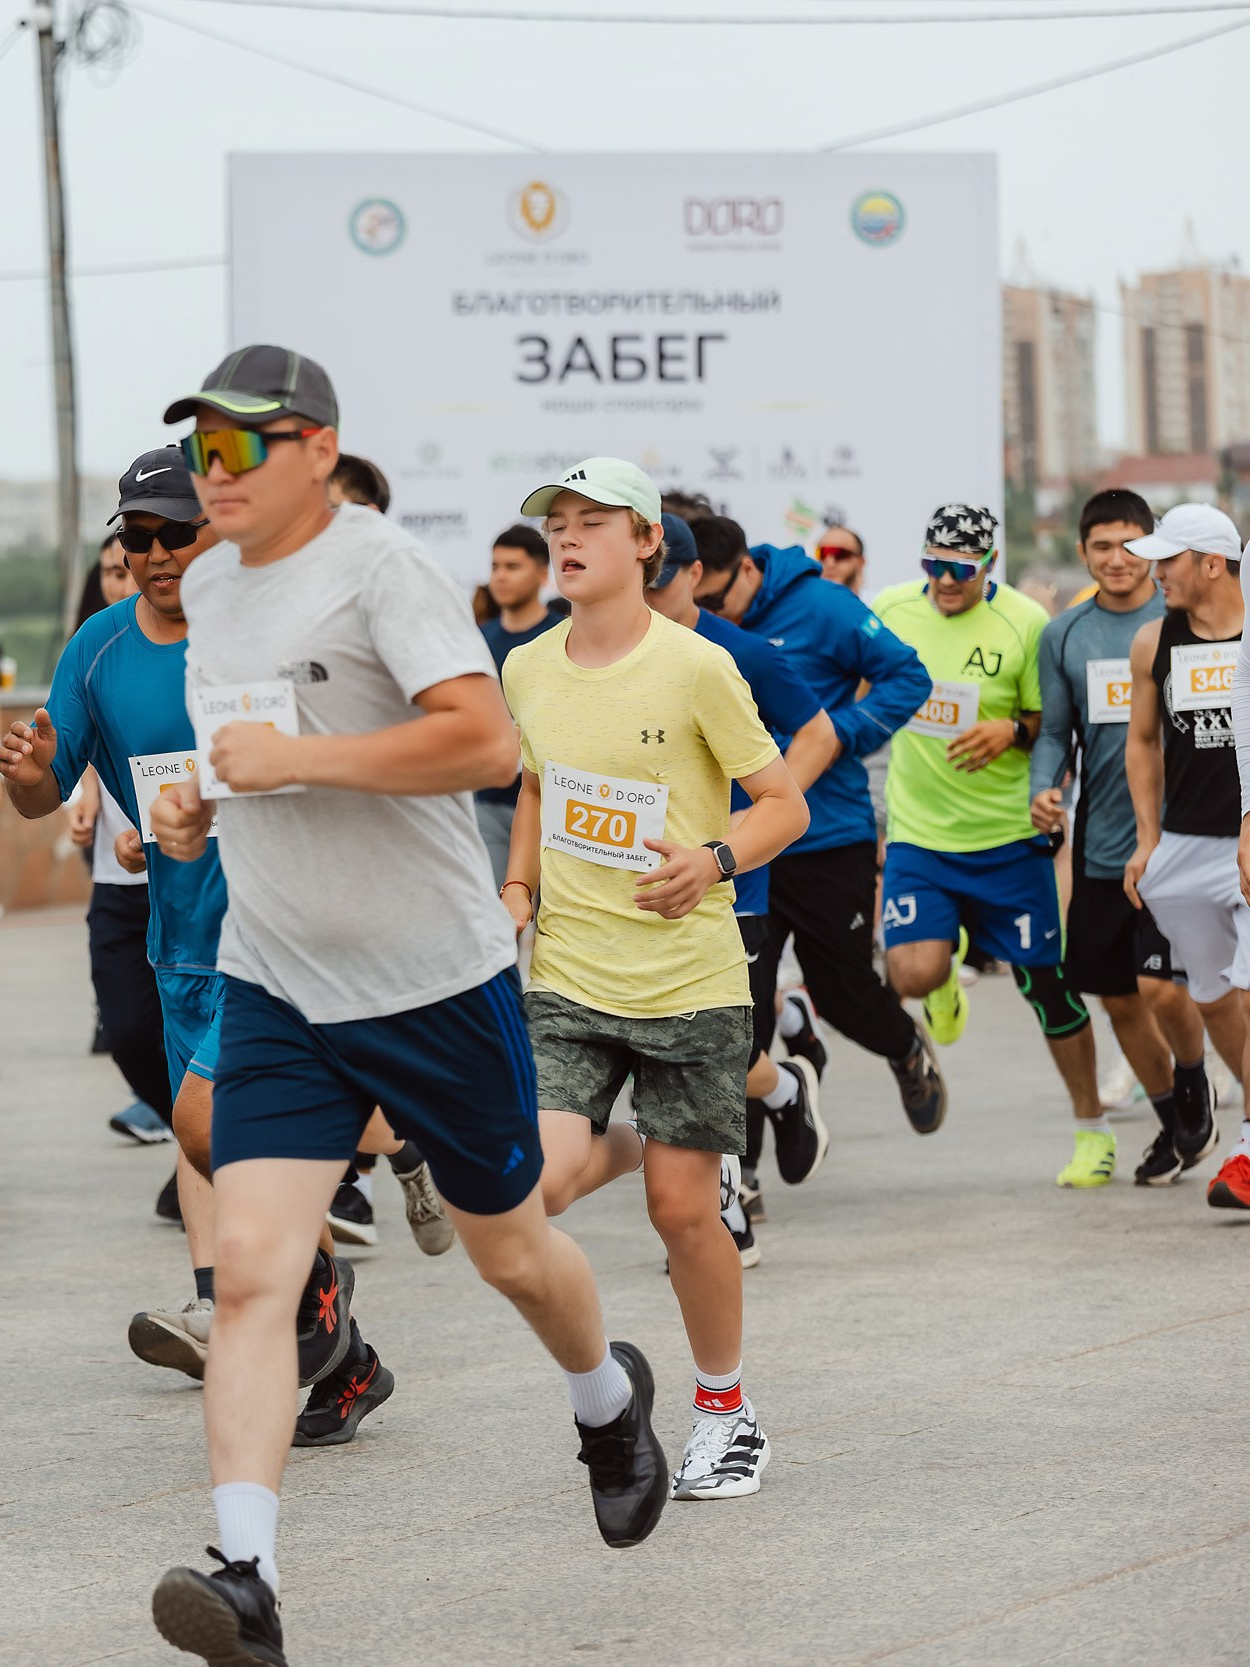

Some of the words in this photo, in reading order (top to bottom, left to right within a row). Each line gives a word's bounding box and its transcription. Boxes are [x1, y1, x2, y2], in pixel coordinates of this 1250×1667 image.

[684, 198, 784, 235] DORO
[453, 290, 782, 316] БЛАГОТВОРИТЕЛЬНЫЙ
[516, 334, 728, 383] ЗАБЕГ
[1194, 667, 1234, 691] 346
[203, 700, 237, 715] LEONE
[141, 764, 181, 777] LEONE
[554, 775, 593, 795] LEONE
[616, 790, 655, 806] D'ORO
[570, 806, 628, 842] 270
[552, 834, 625, 859] БЛАГОТВОРИТЕЛЬНЫЙ
[626, 853, 648, 862] ЗАБЕГ
[1014, 913, 1031, 949] 1
